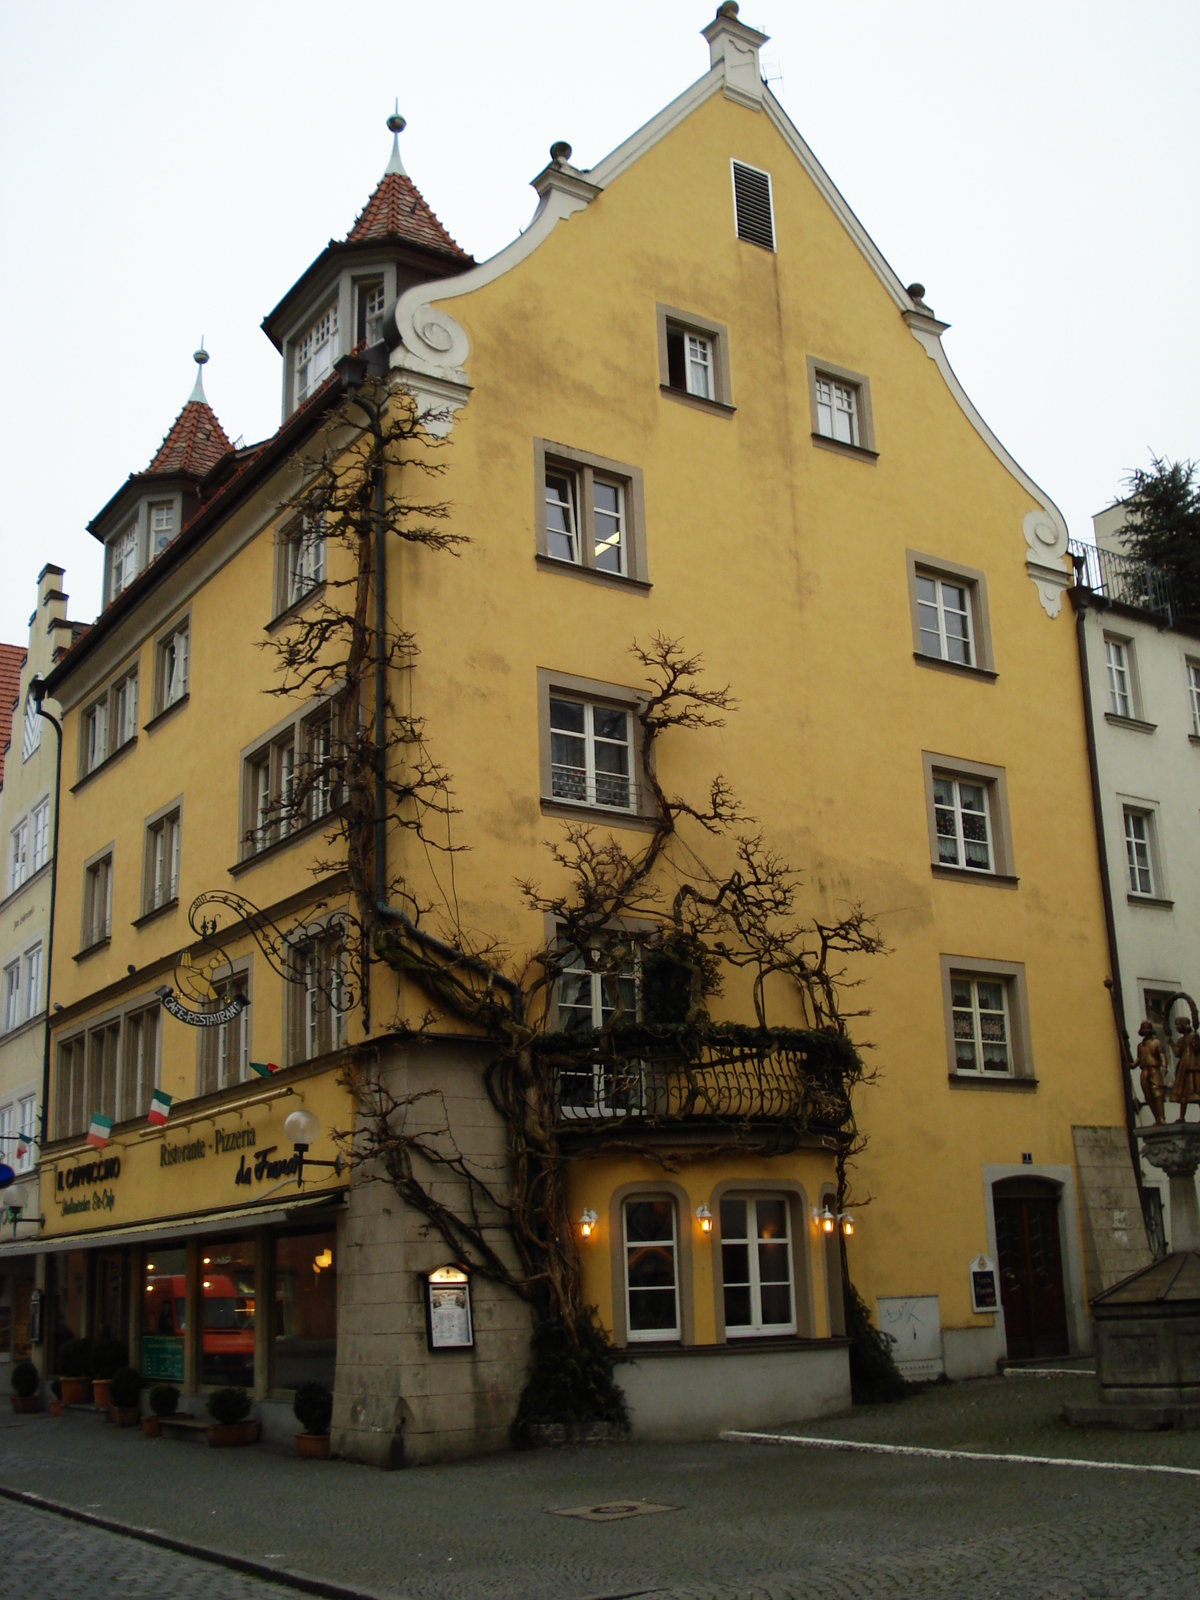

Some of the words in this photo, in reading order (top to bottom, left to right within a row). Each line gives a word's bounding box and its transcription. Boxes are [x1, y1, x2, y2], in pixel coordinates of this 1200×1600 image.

[160, 1138, 206, 1167] Ristorante
[214, 1122, 256, 1155] Pizzeria
[57, 1171, 64, 1191] IL
[66, 1155, 121, 1190] CAPPUCCINO
[235, 1154, 252, 1185] da
